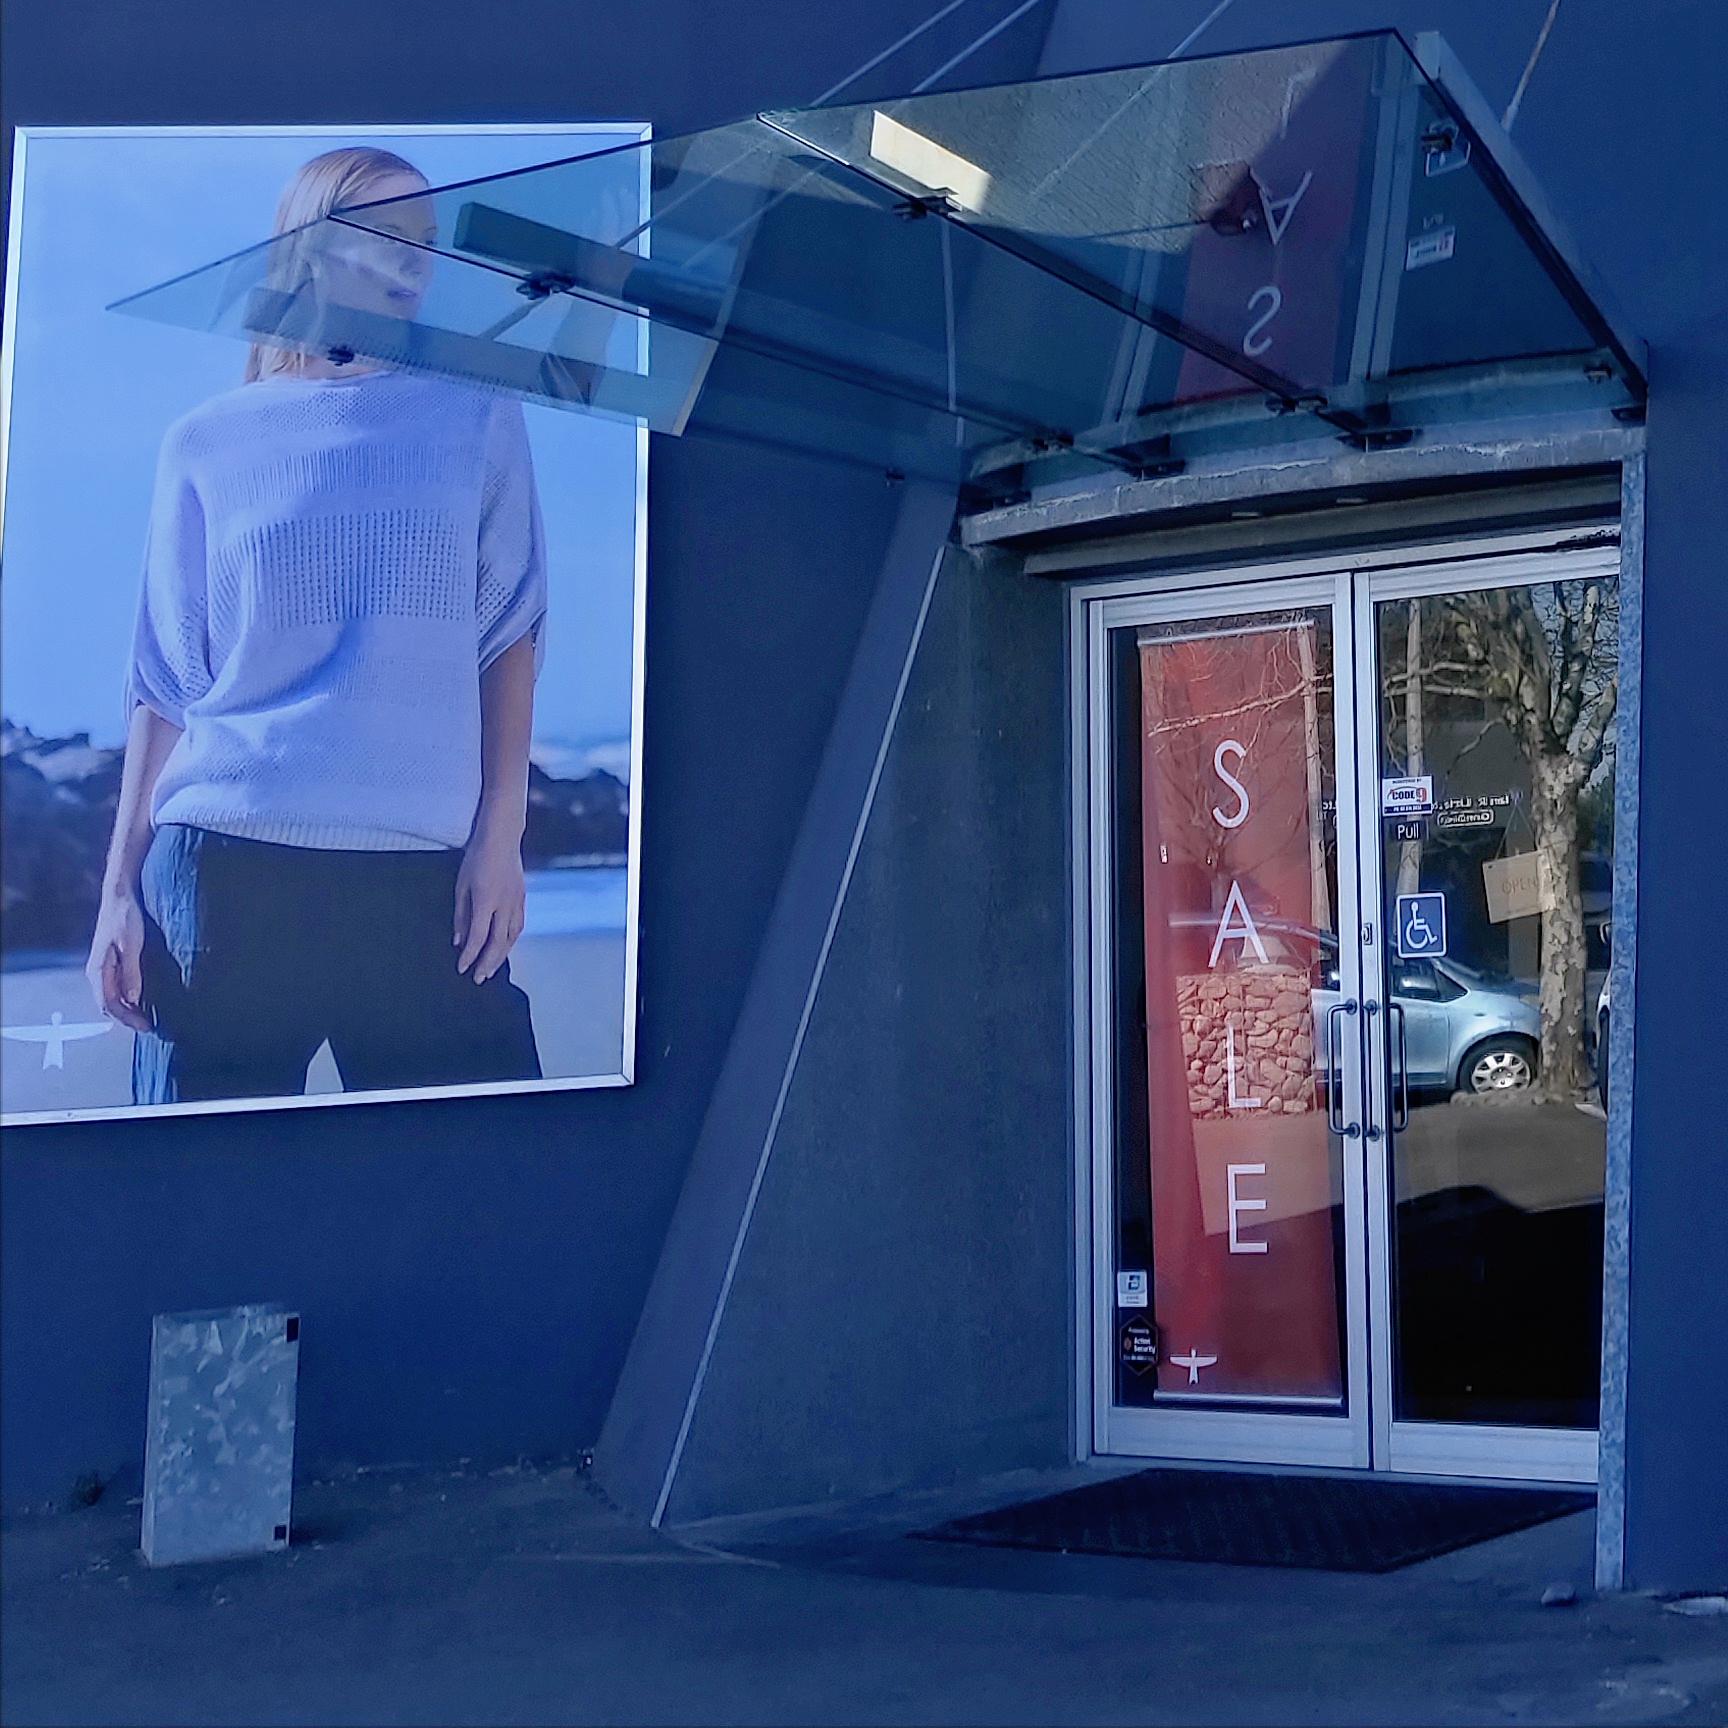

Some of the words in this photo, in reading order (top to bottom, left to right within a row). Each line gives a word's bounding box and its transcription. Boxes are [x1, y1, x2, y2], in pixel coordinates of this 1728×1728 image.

[1391, 789, 1416, 801] CODE
[1396, 821, 1419, 840] Pull
[1207, 738, 1269, 1255] SALE
